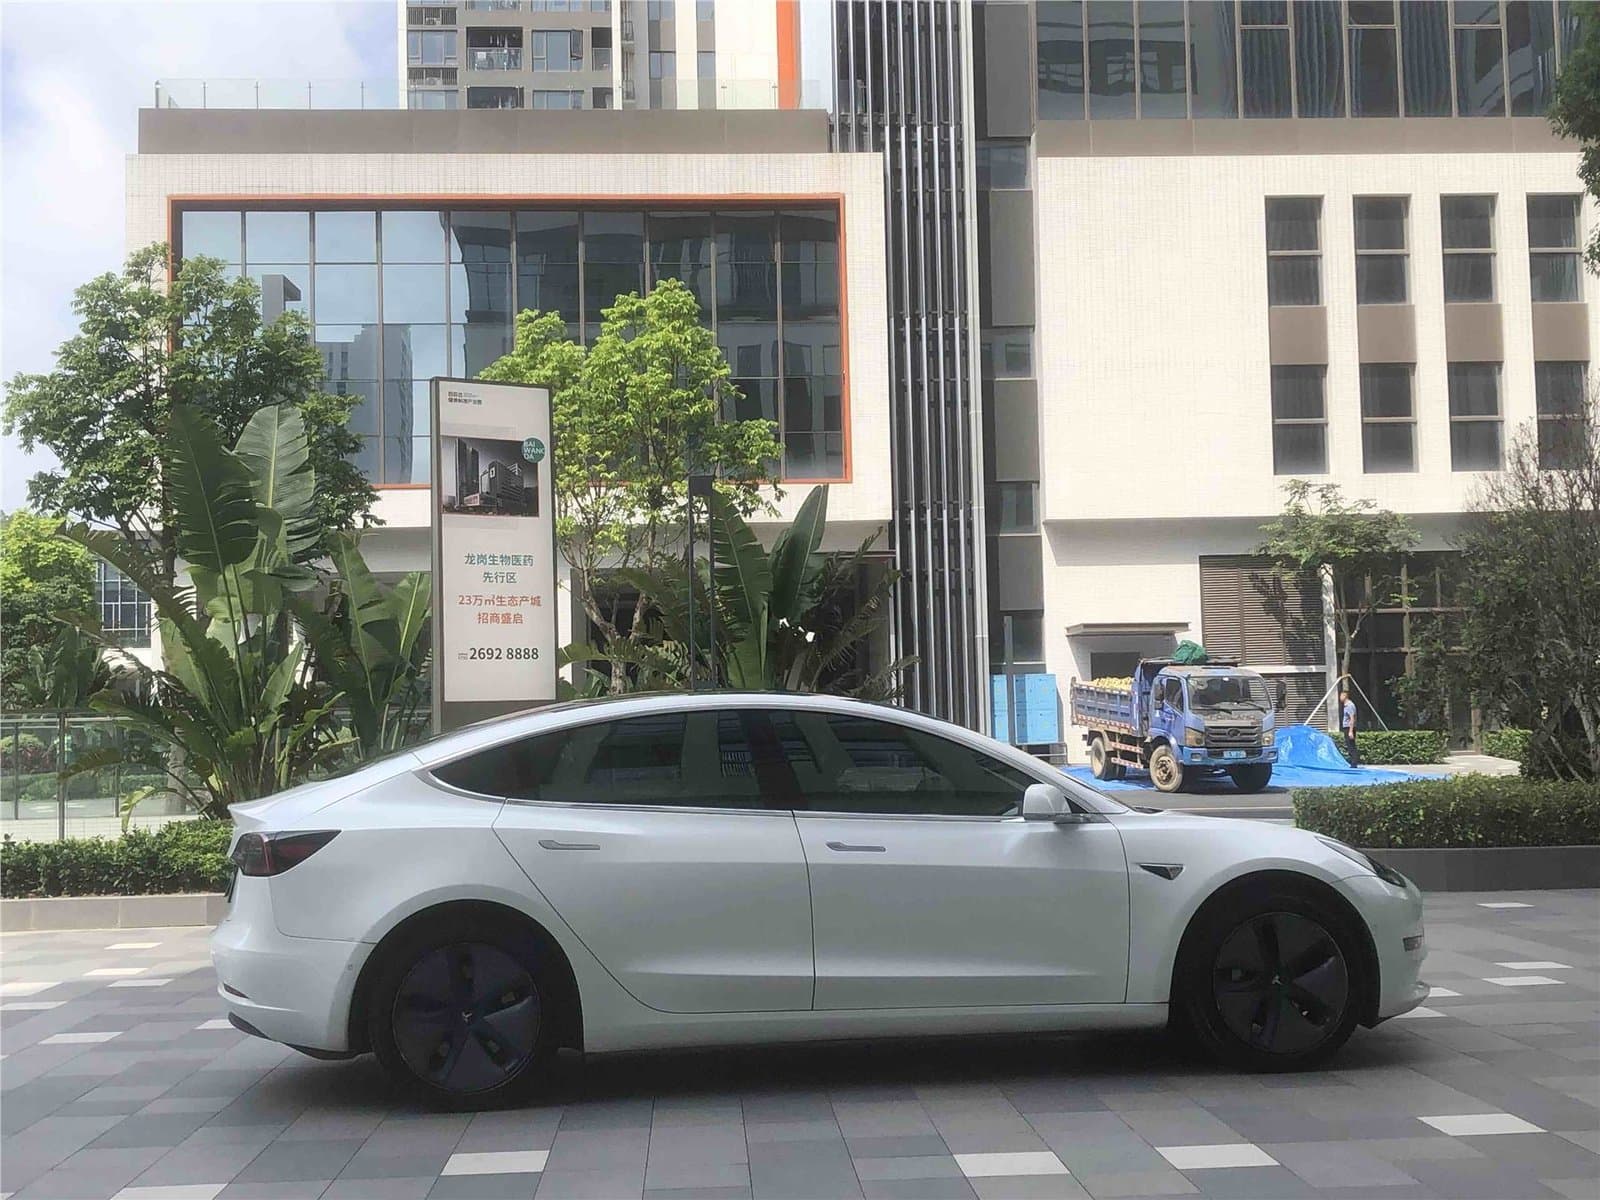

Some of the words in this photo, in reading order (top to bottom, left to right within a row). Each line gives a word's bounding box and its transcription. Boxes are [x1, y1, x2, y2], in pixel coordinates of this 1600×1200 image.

[464, 553, 534, 567] 龙岗生物医药
[482, 571, 517, 584] 先行区
[477, 612, 524, 625] 招商盛启
[469, 647, 502, 660] 2692
[506, 647, 540, 661] 8888
